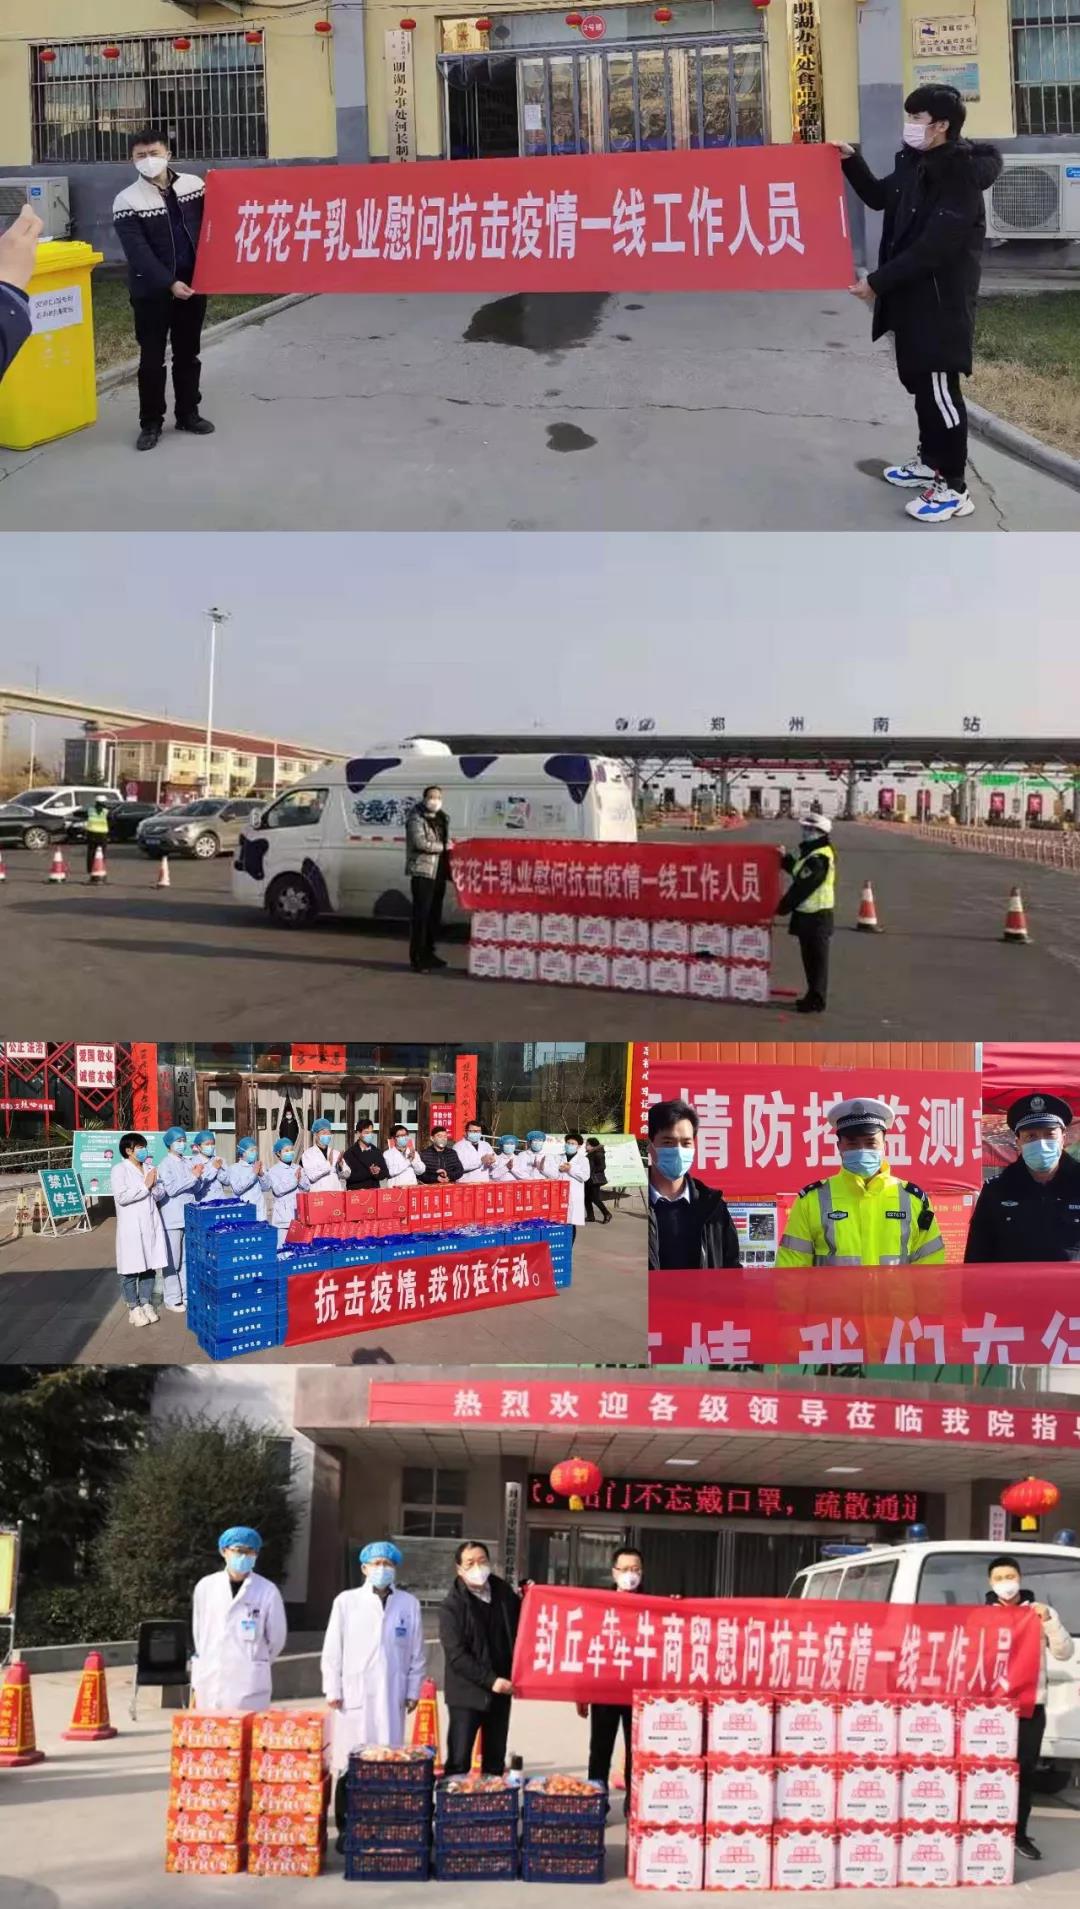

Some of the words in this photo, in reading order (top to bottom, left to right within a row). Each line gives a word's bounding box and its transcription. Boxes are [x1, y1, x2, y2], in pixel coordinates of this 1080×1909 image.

[235, 182, 804, 263] 花花牛乳业慰问抗击疫情一线工作人员
[710, 716, 981, 732] 郑州南站
[450, 858, 760, 902] 花花牛乳业慰问抗击疫情一线工作人员
[648, 1088, 981, 1169] 情防控监测
[47, 1174, 76, 1189] 禁止
[53, 1192, 79, 1207] 停车
[314, 1253, 540, 1326] 抗击疫情，我们在行动。
[453, 1389, 1080, 1441] 热烈欢迎各级领导莅临我院指
